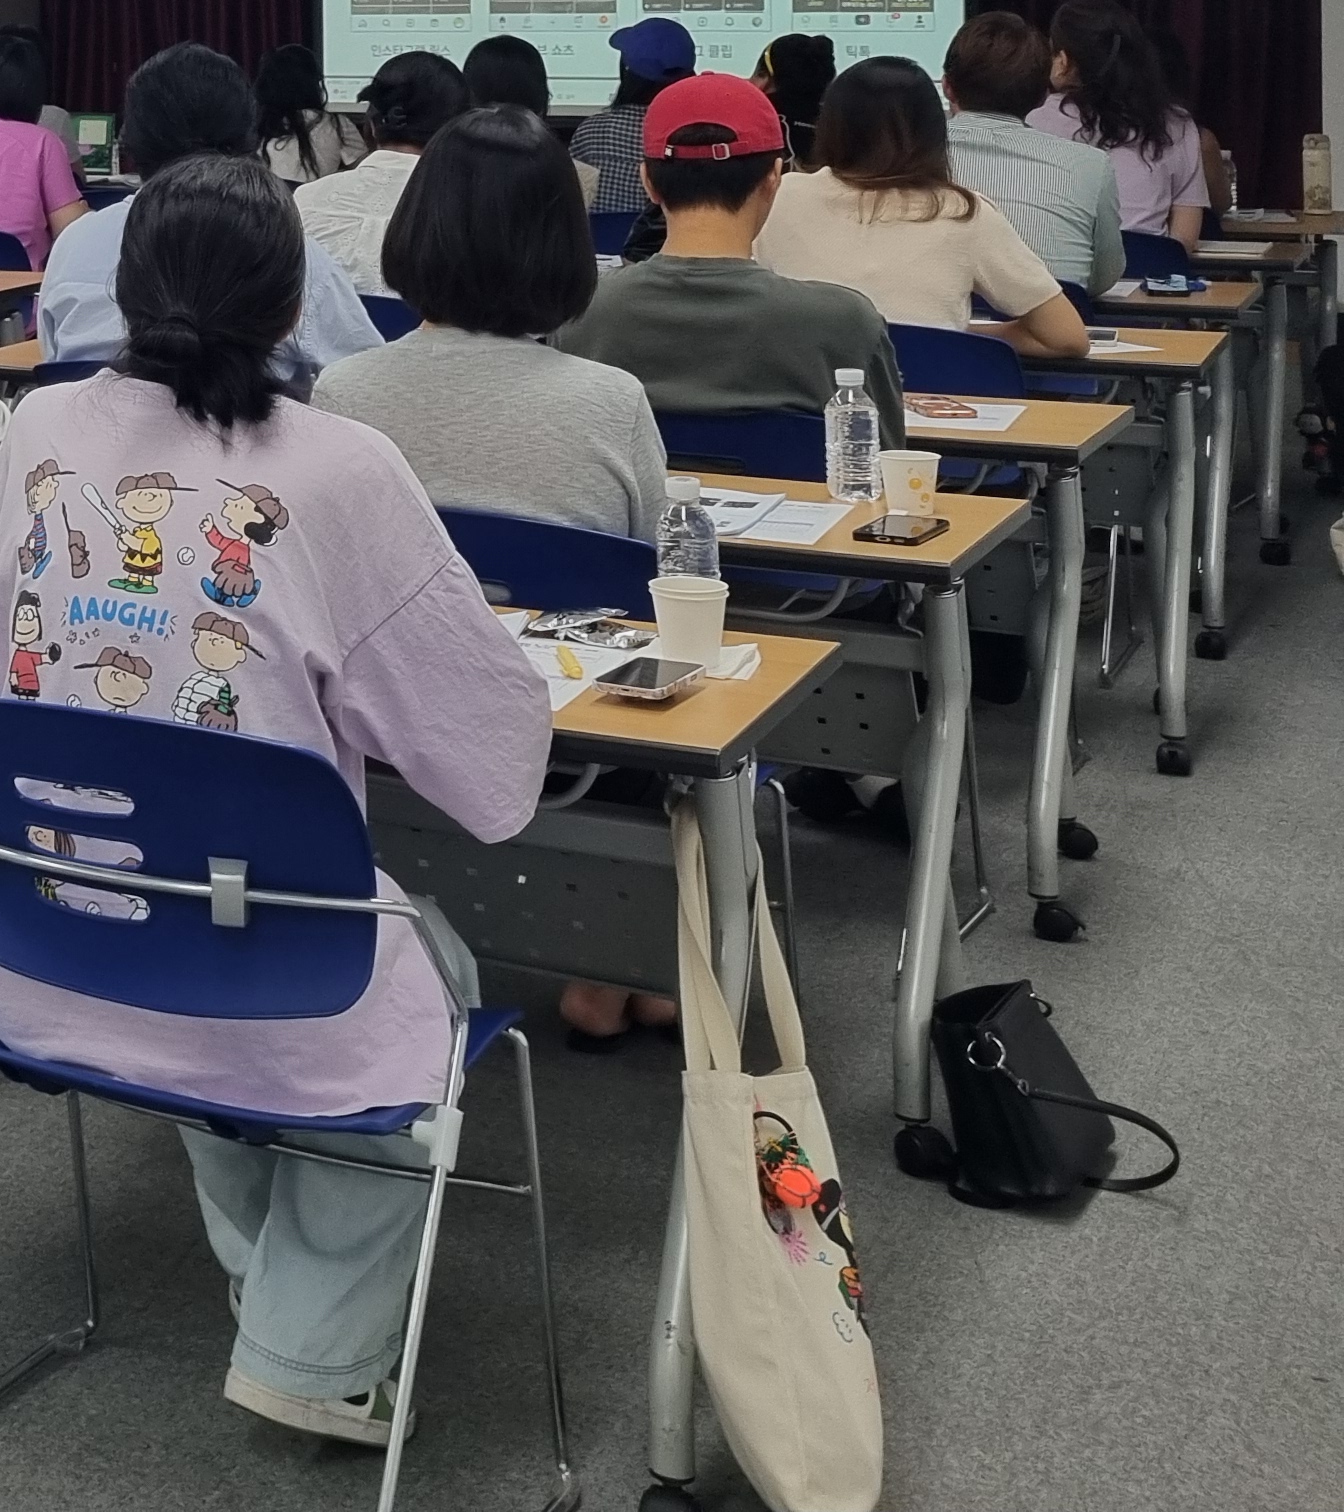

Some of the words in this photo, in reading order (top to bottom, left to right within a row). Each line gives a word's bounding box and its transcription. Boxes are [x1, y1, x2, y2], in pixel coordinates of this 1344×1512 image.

[709, 44, 733, 59] 클립
[845, 45, 871, 60] 틱톡
[68, 595, 169, 637] AAUGH!
